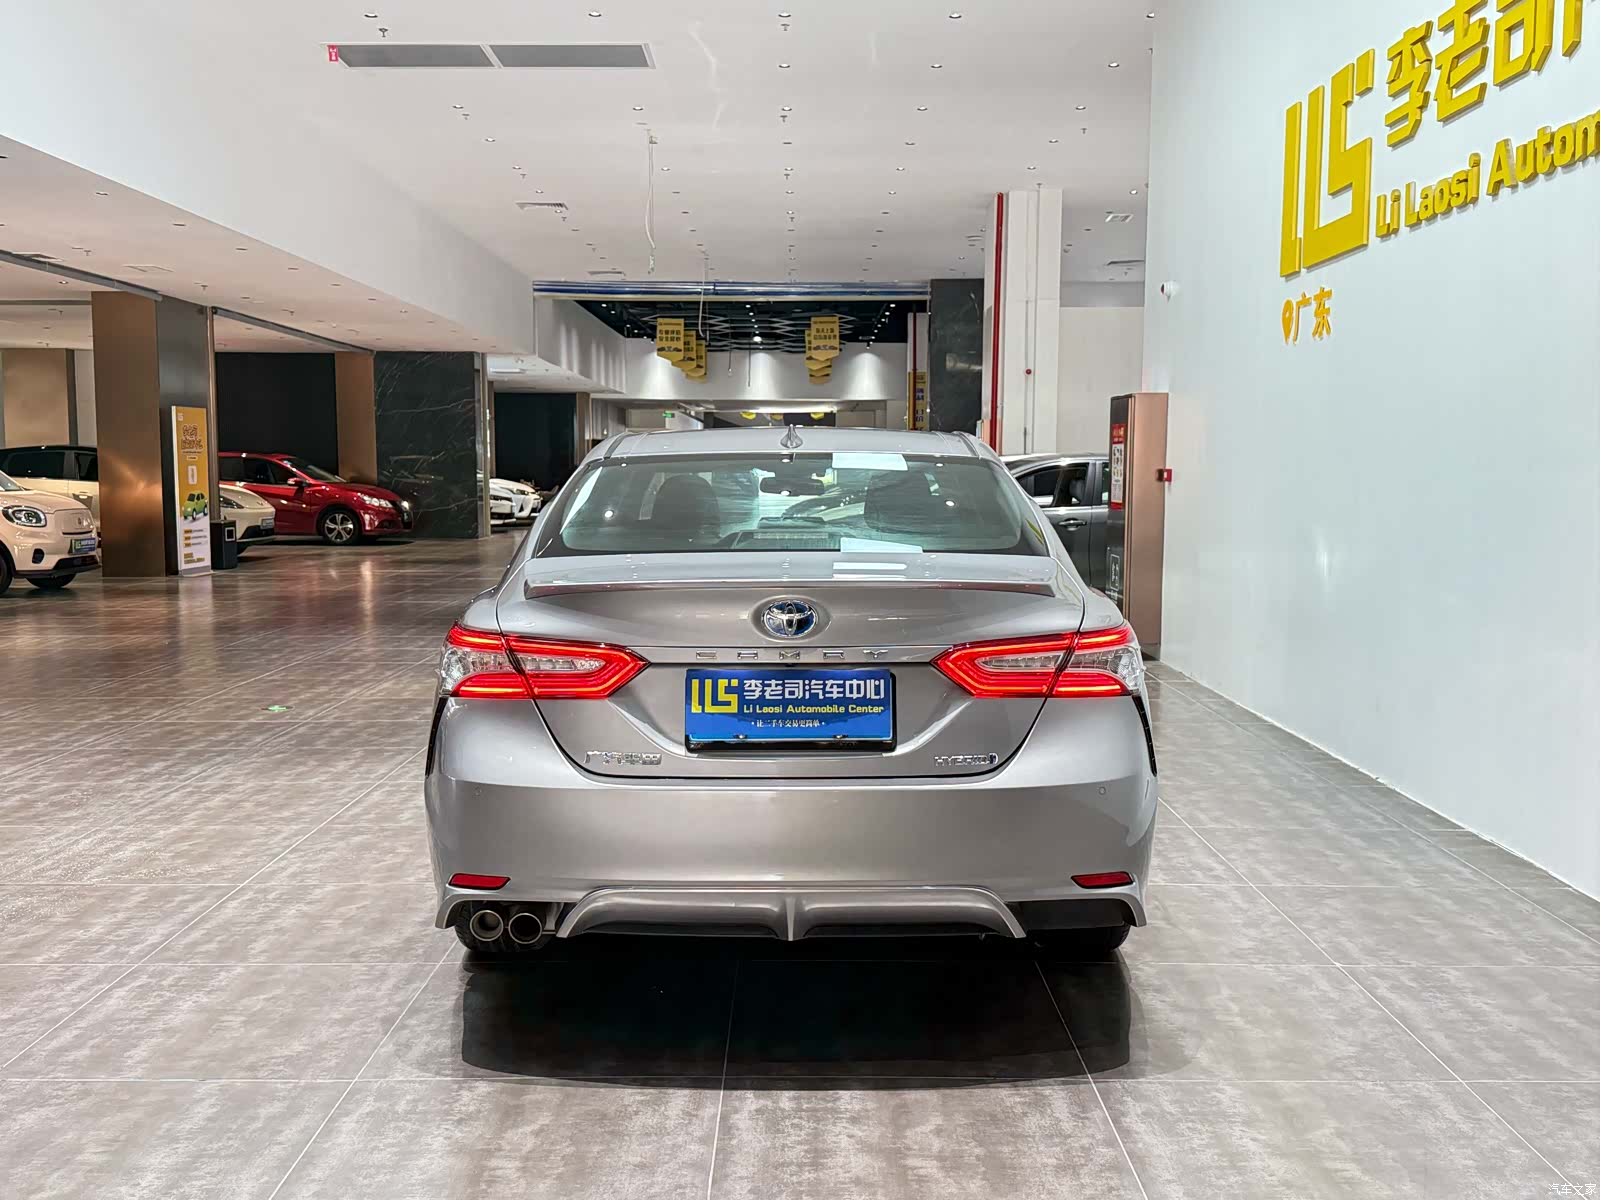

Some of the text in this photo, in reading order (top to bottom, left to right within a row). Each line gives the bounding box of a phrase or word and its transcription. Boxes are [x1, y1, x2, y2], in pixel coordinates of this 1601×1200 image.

[1384, 0, 1582, 148] 李老司
[1375, 188, 1401, 238] Li
[1404, 152, 1481, 228] Laosi
[1293, 286, 1332, 344] 广东
[696, 649, 889, 660] CAMRY
[743, 679, 885, 700] 李老司汽车中心
[743, 704, 885, 714] Li Laosi Automobile Center
